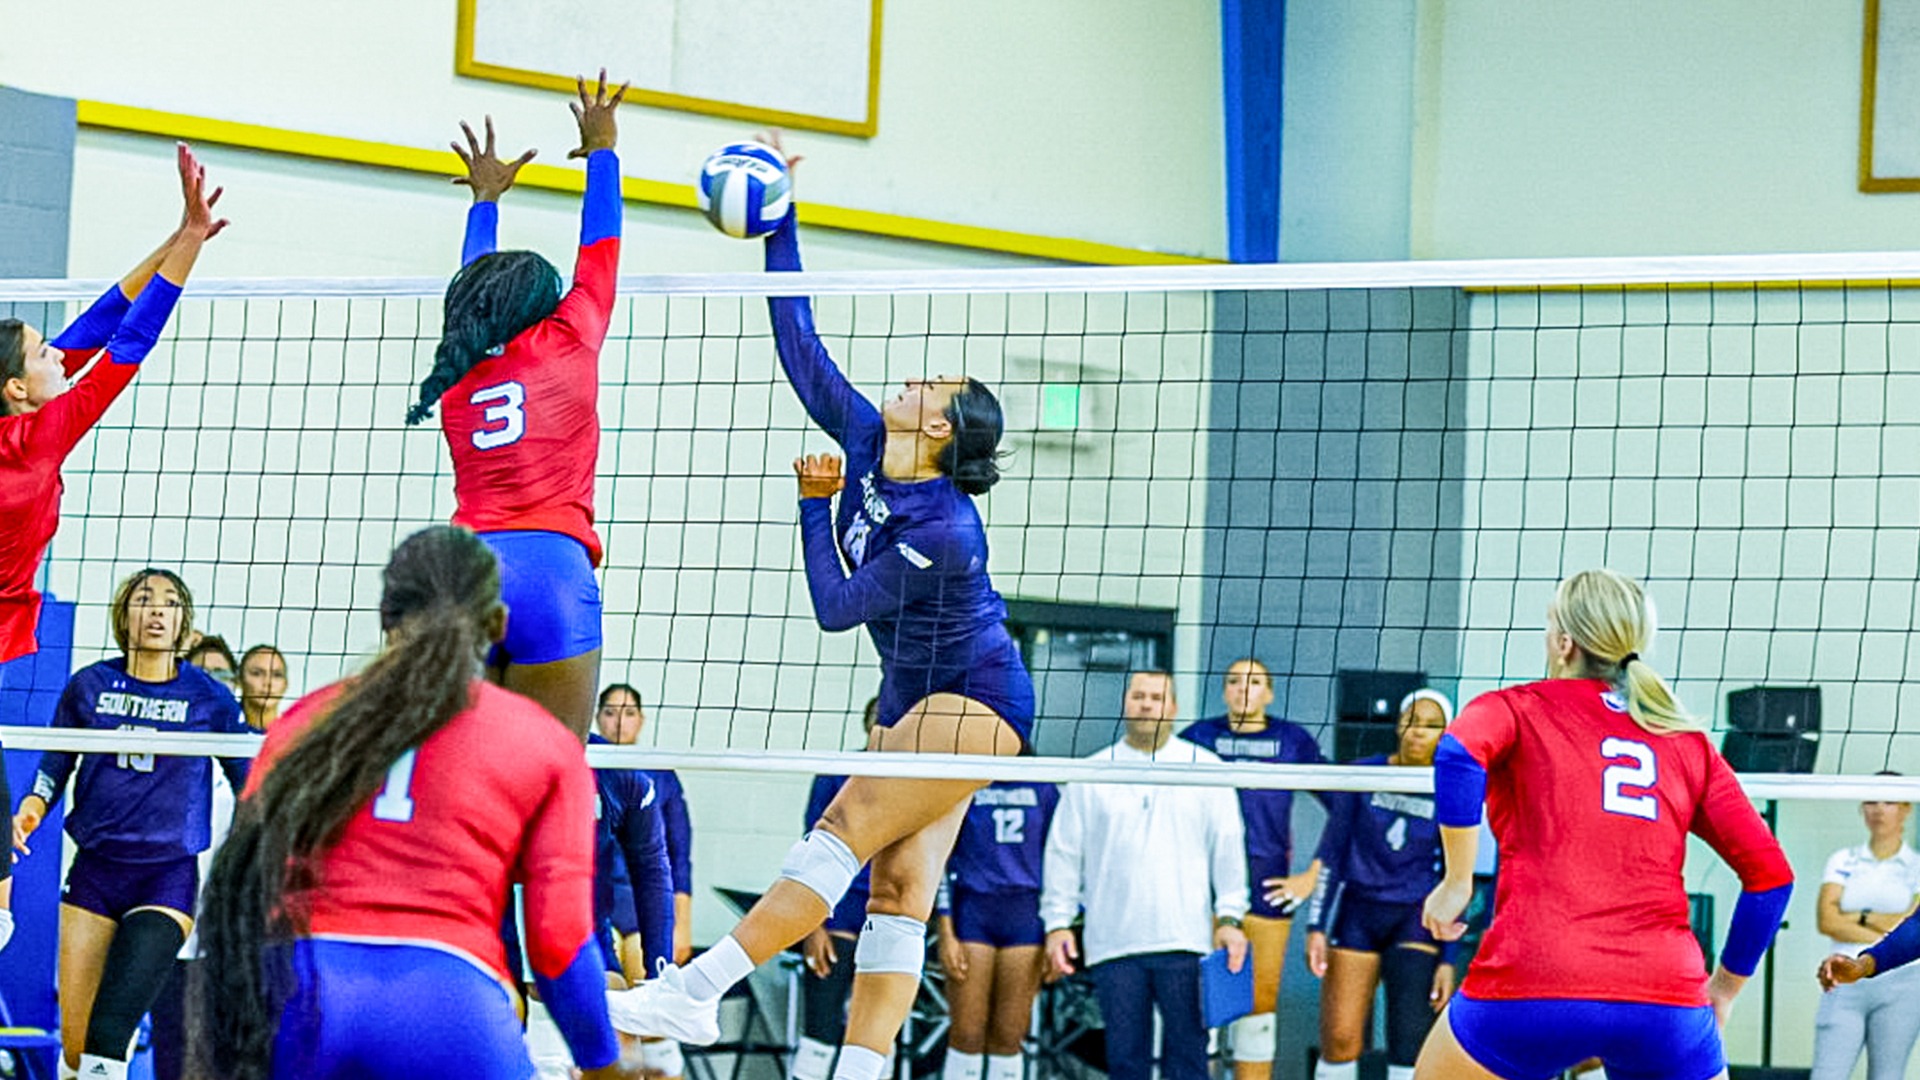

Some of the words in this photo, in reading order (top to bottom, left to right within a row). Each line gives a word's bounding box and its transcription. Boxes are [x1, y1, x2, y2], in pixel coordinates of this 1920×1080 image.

[469, 380, 526, 451] 3
[96, 692, 189, 723] SOUTHERN
[1600, 735, 1658, 822] 2
[992, 808, 1024, 844] 12
[1386, 816, 1407, 851] 4
